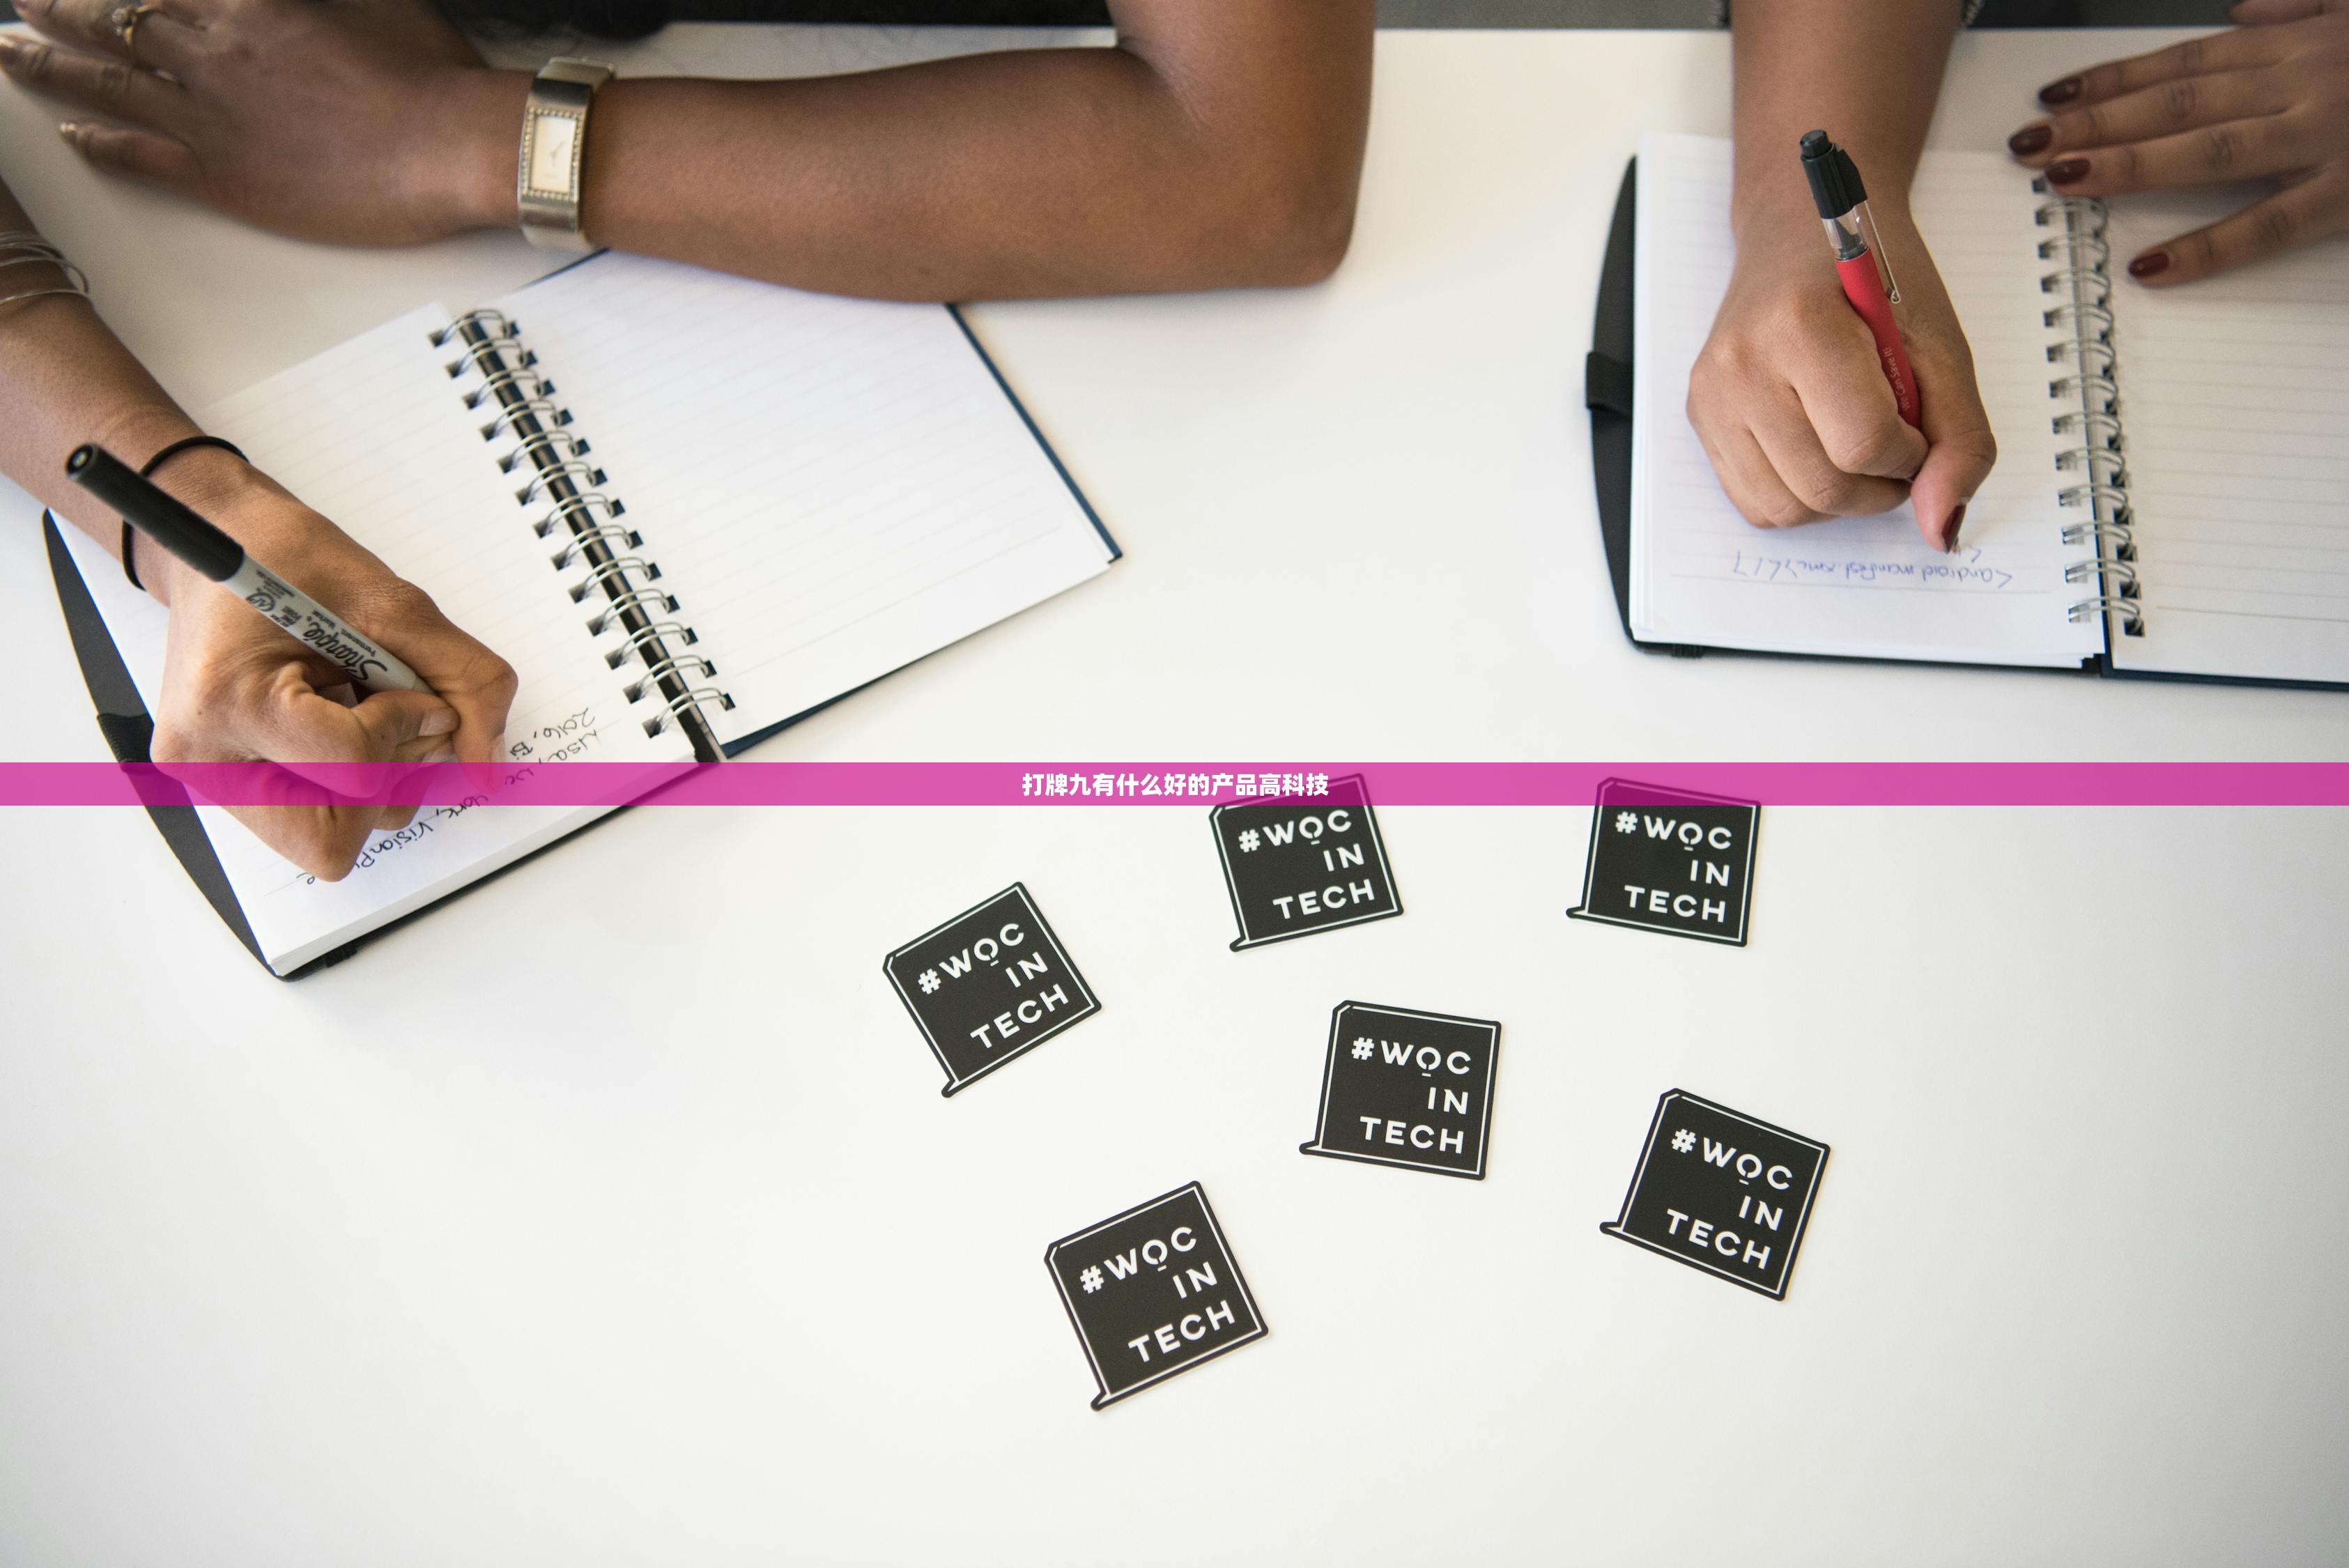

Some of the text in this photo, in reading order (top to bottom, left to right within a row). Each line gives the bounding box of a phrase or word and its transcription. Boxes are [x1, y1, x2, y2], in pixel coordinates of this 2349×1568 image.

[1888, 357, 1900, 378] Save
[1895, 378, 1906, 396] Can
[302, 621, 387, 681] Sharpie
[1323, 843, 1364, 872] IN
[1690, 859, 1730, 887] IN
[1272, 878, 1375, 919] TECH
[1624, 884, 1726, 923] TECH
[1005, 951, 1049, 988] IN
[969, 983, 1069, 1049] TECH
[1427, 1086, 1469, 1115] IN
[1360, 1116, 1464, 1154] TECH
[1739, 1195, 1783, 1231] IN
[1667, 1208, 1771, 1270] TECH
[1172, 1261, 1218, 1299] IN
[1127, 1300, 1235, 1362] TECH
